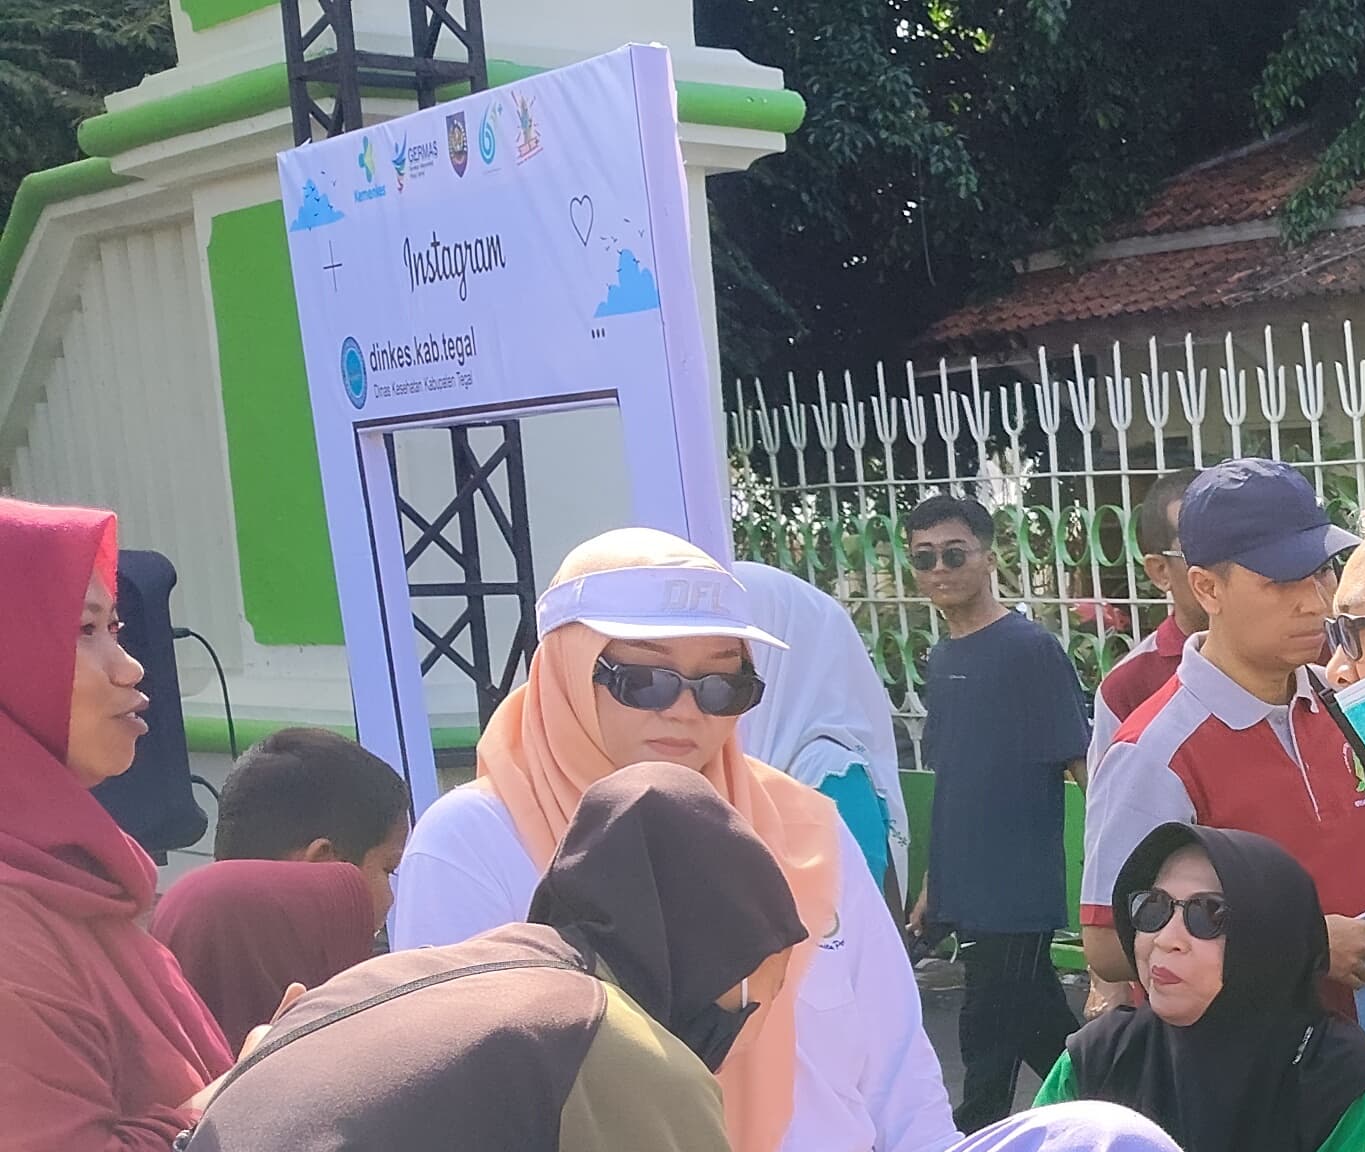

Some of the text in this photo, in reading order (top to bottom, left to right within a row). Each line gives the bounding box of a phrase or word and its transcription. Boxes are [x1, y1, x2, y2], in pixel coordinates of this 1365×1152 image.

[408, 140, 438, 163] GERMAS
[404, 231, 506, 301] Instagram
[369, 325, 477, 373] dinkes.kab.tegal
[373, 383, 391, 398] Dinas
[456, 371, 473, 390] Tegal
